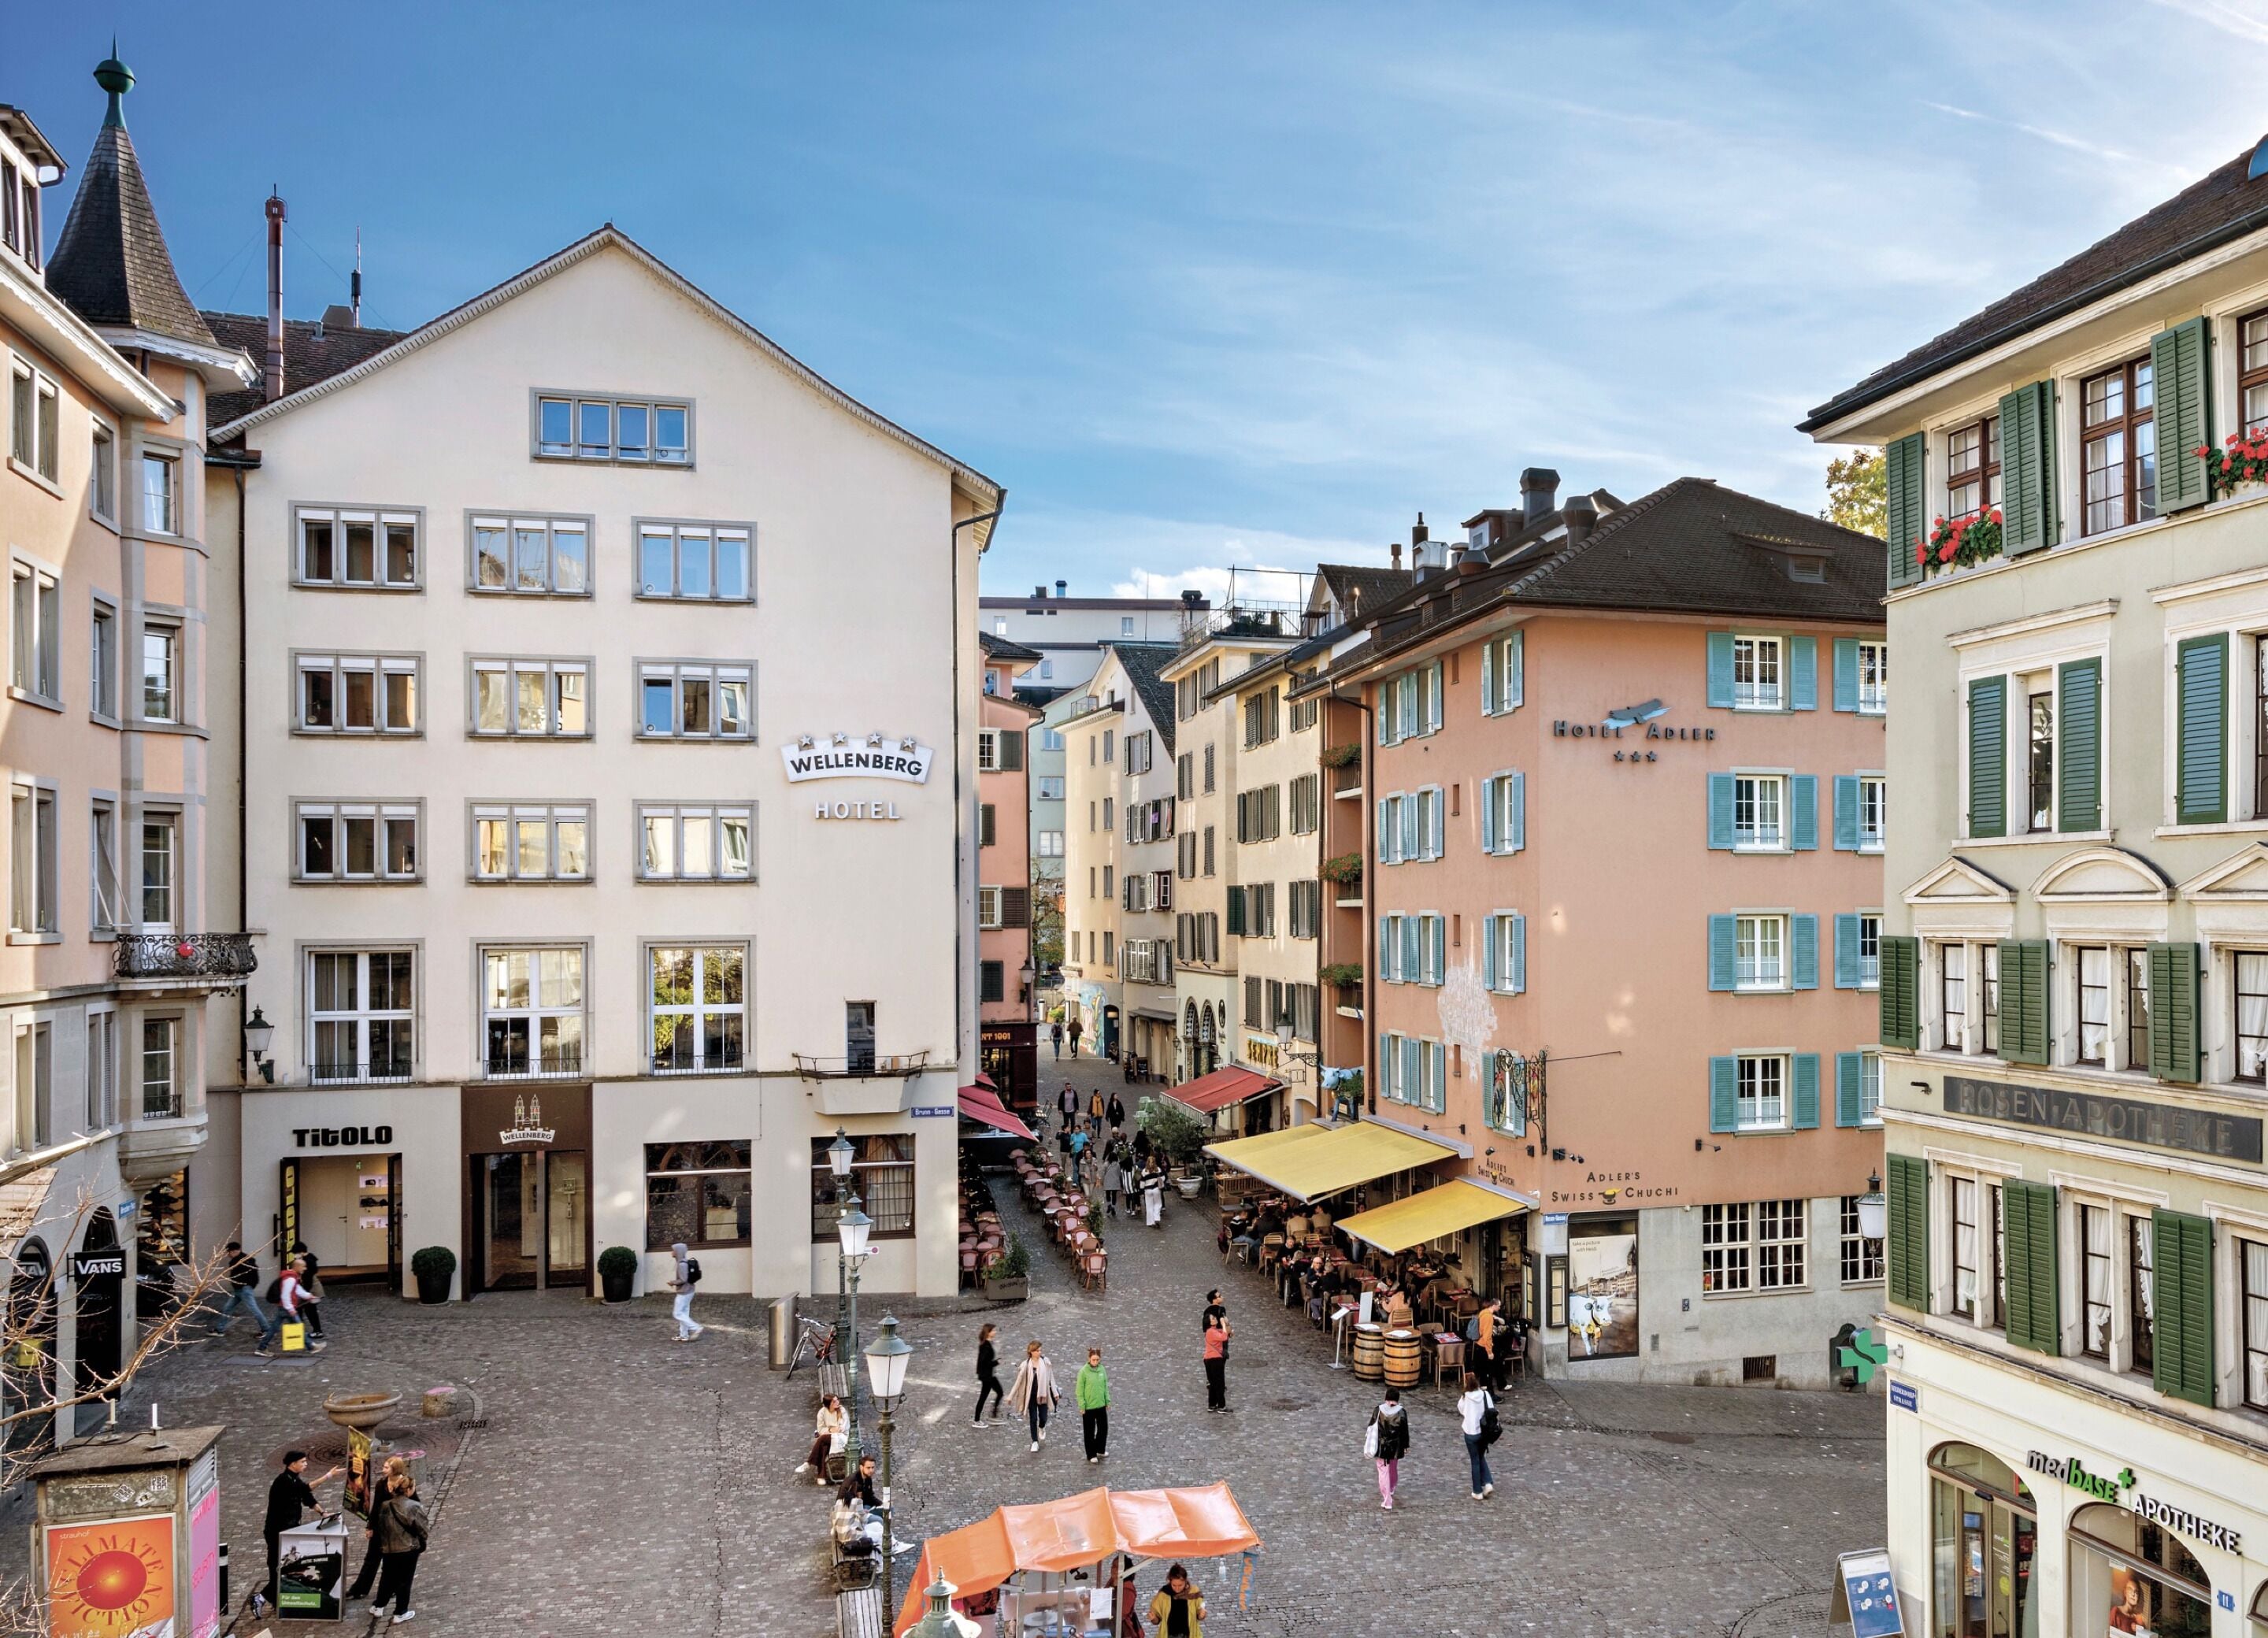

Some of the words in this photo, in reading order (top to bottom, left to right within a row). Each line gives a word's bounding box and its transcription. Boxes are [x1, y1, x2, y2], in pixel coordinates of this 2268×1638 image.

[1554, 720, 1624, 739] HOTEL
[1646, 722, 1716, 741] ADLER
[790, 753, 922, 776] WELLENBERG
[815, 801, 900, 819] HOTEL
[1587, 1171, 1640, 1182] ADLER'S
[1551, 1191, 1594, 1203] SWISS
[1625, 1187, 1678, 1198] CHUCHI
[76, 1258, 122, 1274] VANS
[2133, 1494, 2241, 1556] APOTHEKE
[59, 1530, 91, 1540] strauhof
